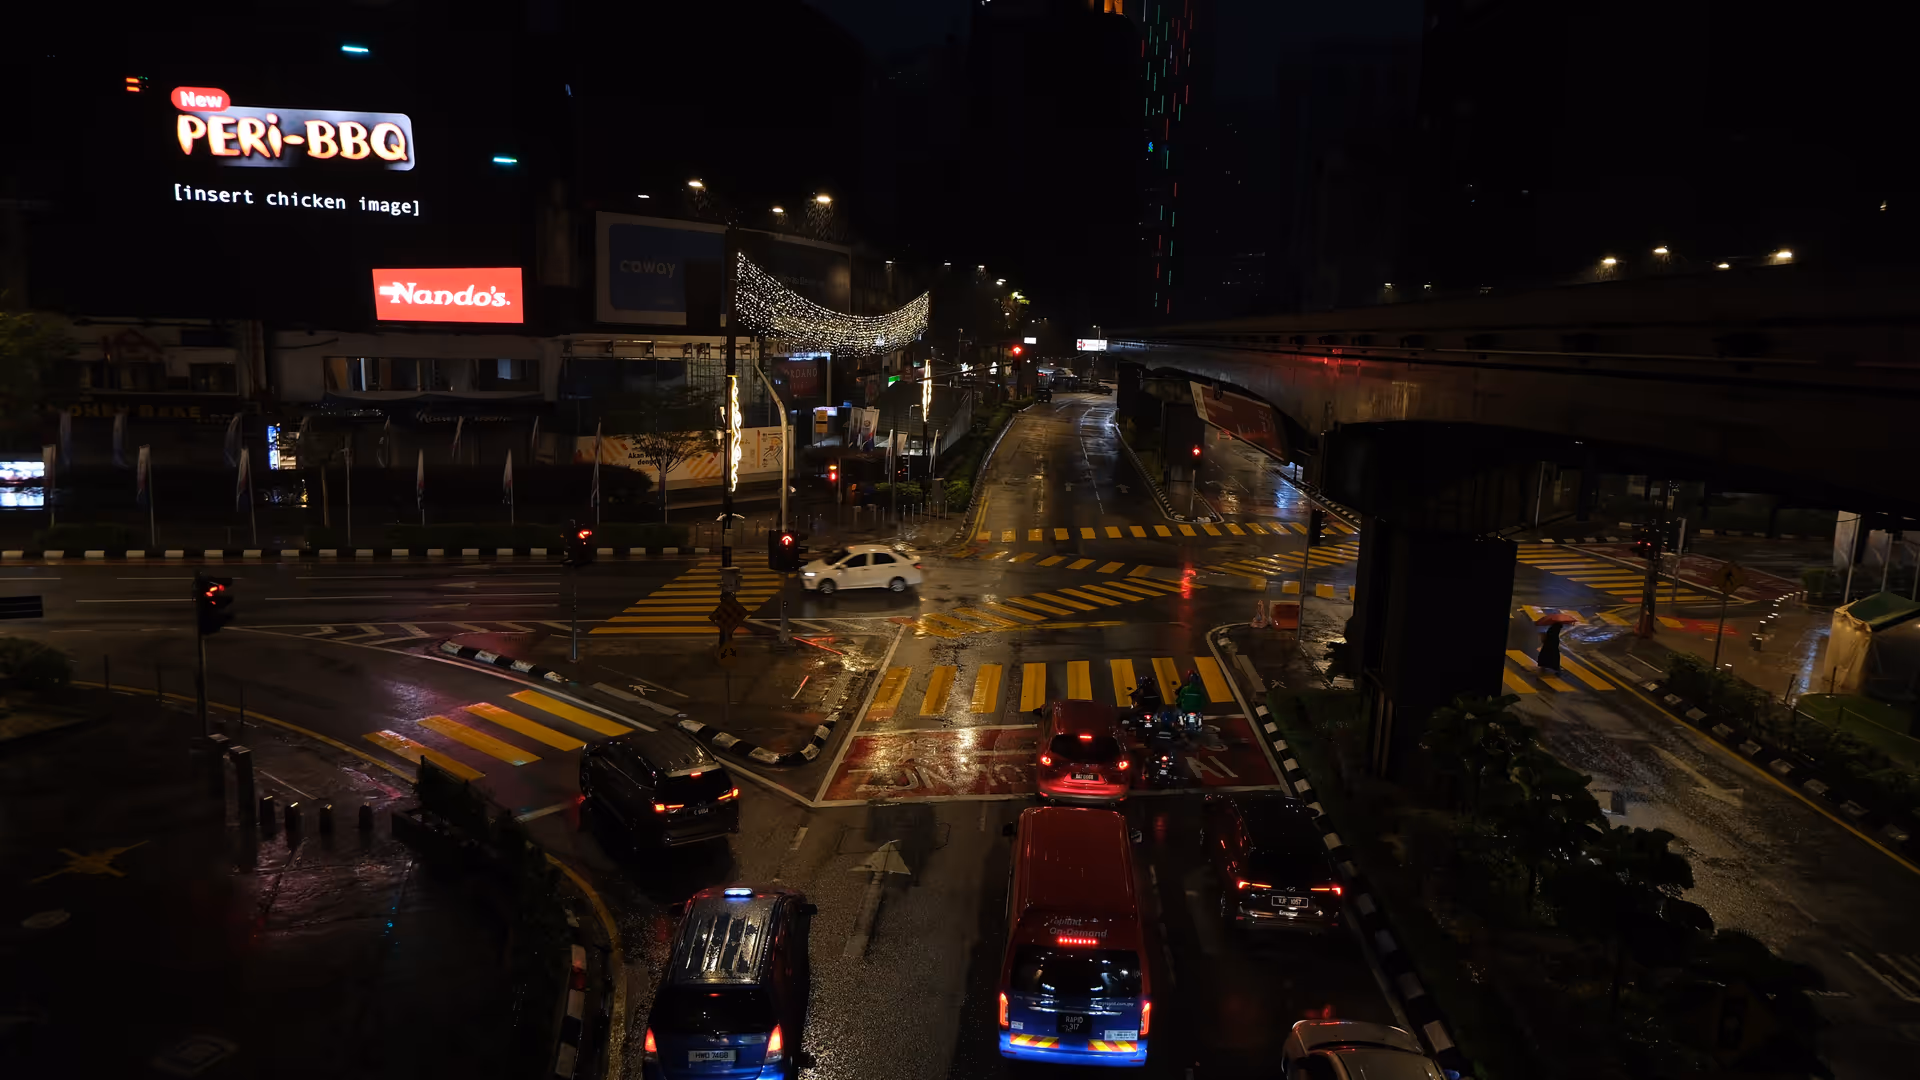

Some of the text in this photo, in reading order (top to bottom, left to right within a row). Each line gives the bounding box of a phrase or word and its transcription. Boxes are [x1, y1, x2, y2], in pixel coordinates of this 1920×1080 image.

[180, 91, 223, 108] New
[174, 183, 420, 216] [insert chicken image]
[1049, 926, 1108, 938] On-Demand
[1065, 1016, 1084, 1024] RAPID
[1069, 1023, 1080, 1031] 317
